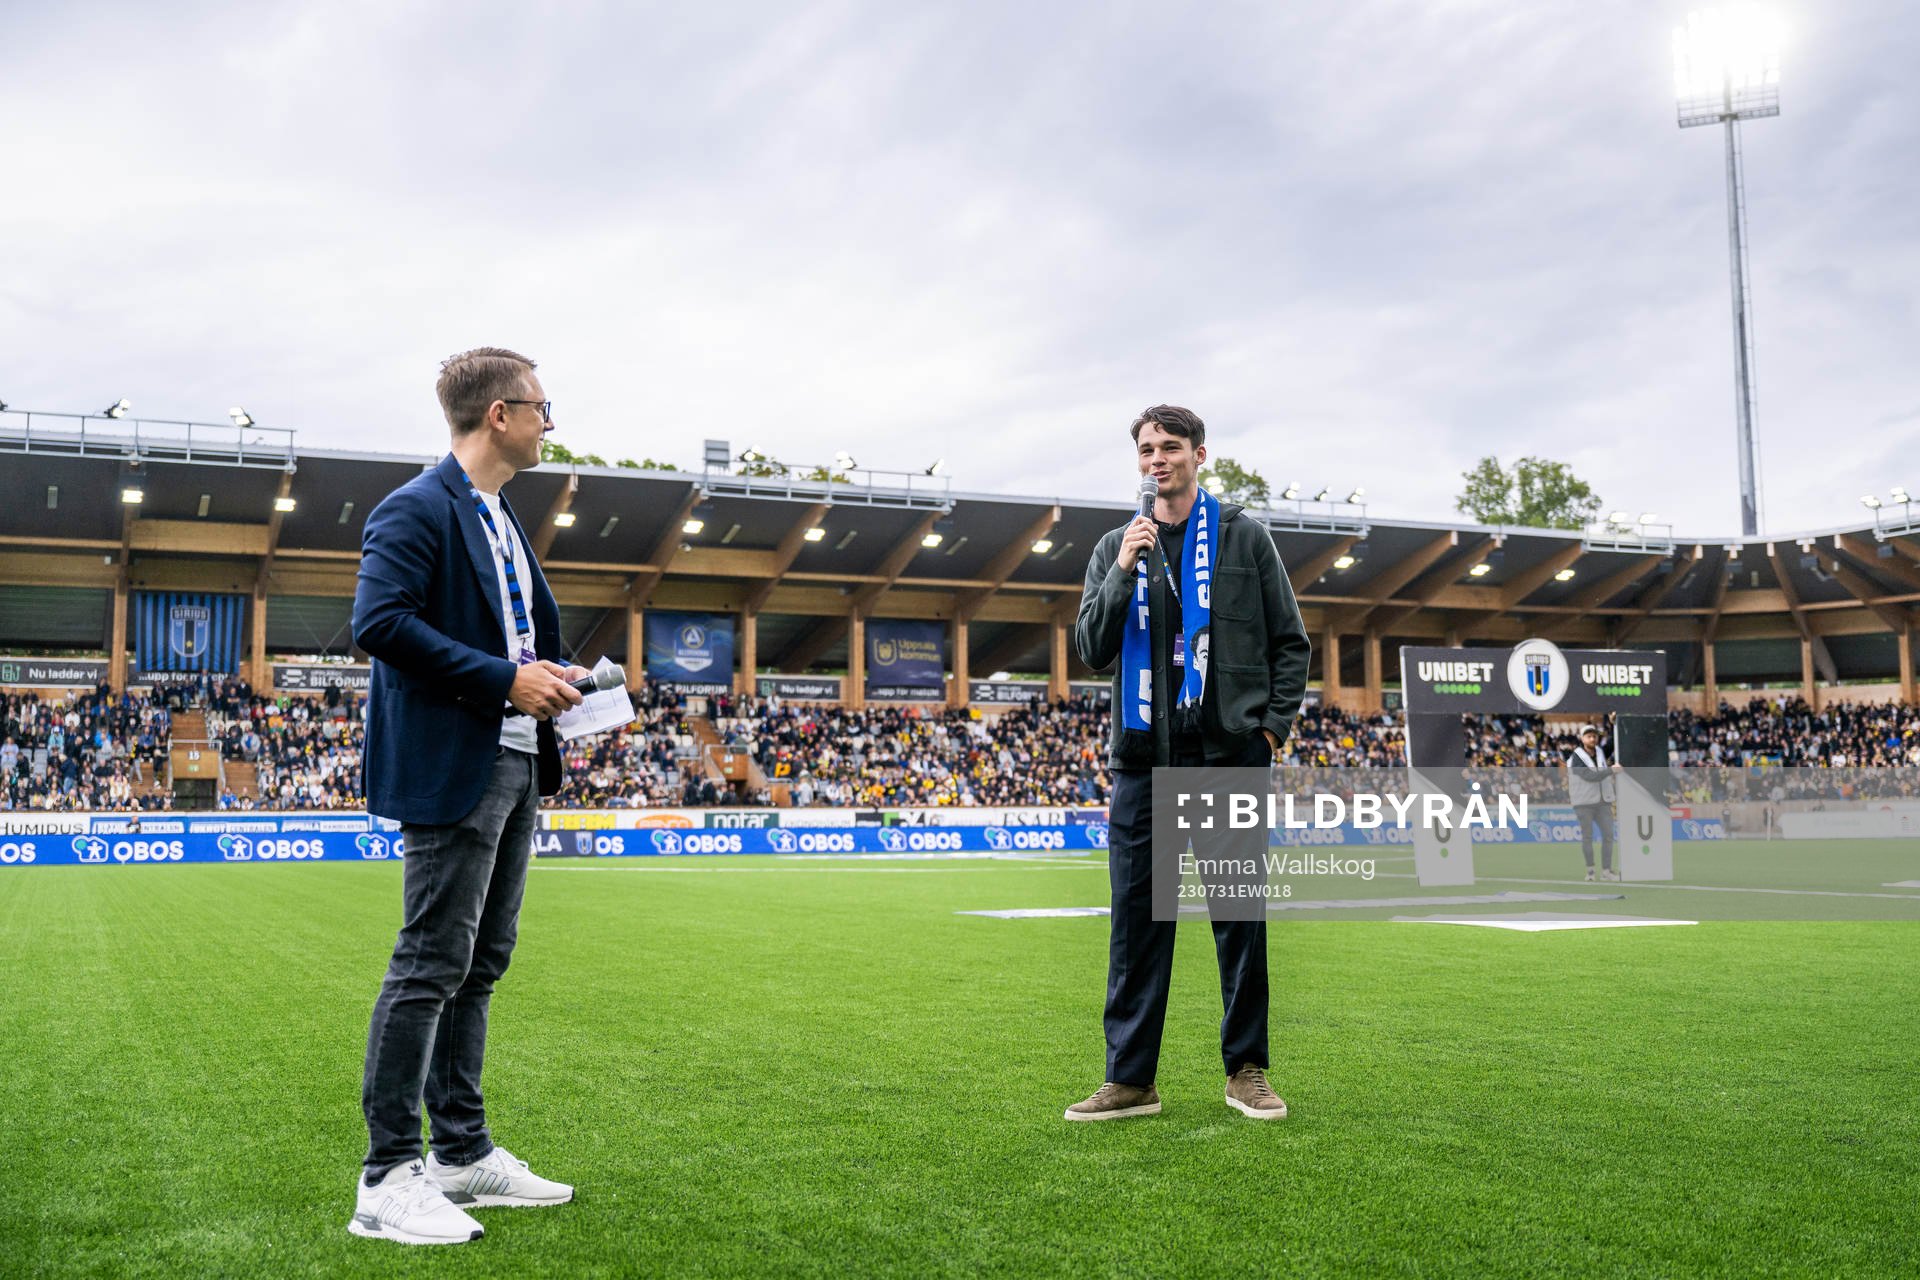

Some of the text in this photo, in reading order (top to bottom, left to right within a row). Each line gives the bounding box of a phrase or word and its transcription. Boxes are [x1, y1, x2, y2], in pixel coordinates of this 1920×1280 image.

[899, 639, 936, 650] Uppsala
[29, 668, 98, 680] Nu laddar vi
[1418, 662, 1494, 682] UNIBET
[1582, 665, 1653, 684] UNIBET
[713, 813, 769, 829] notar
[1637, 815, 1653, 841] U
[256, 839, 324, 859] OBOS
[684, 835, 742, 854] OBOS
[800, 833, 855, 851] OBOS
[908, 832, 963, 850] OBOS
[1013, 831, 1066, 849] OBOS
[113, 841, 184, 861] OBOS
